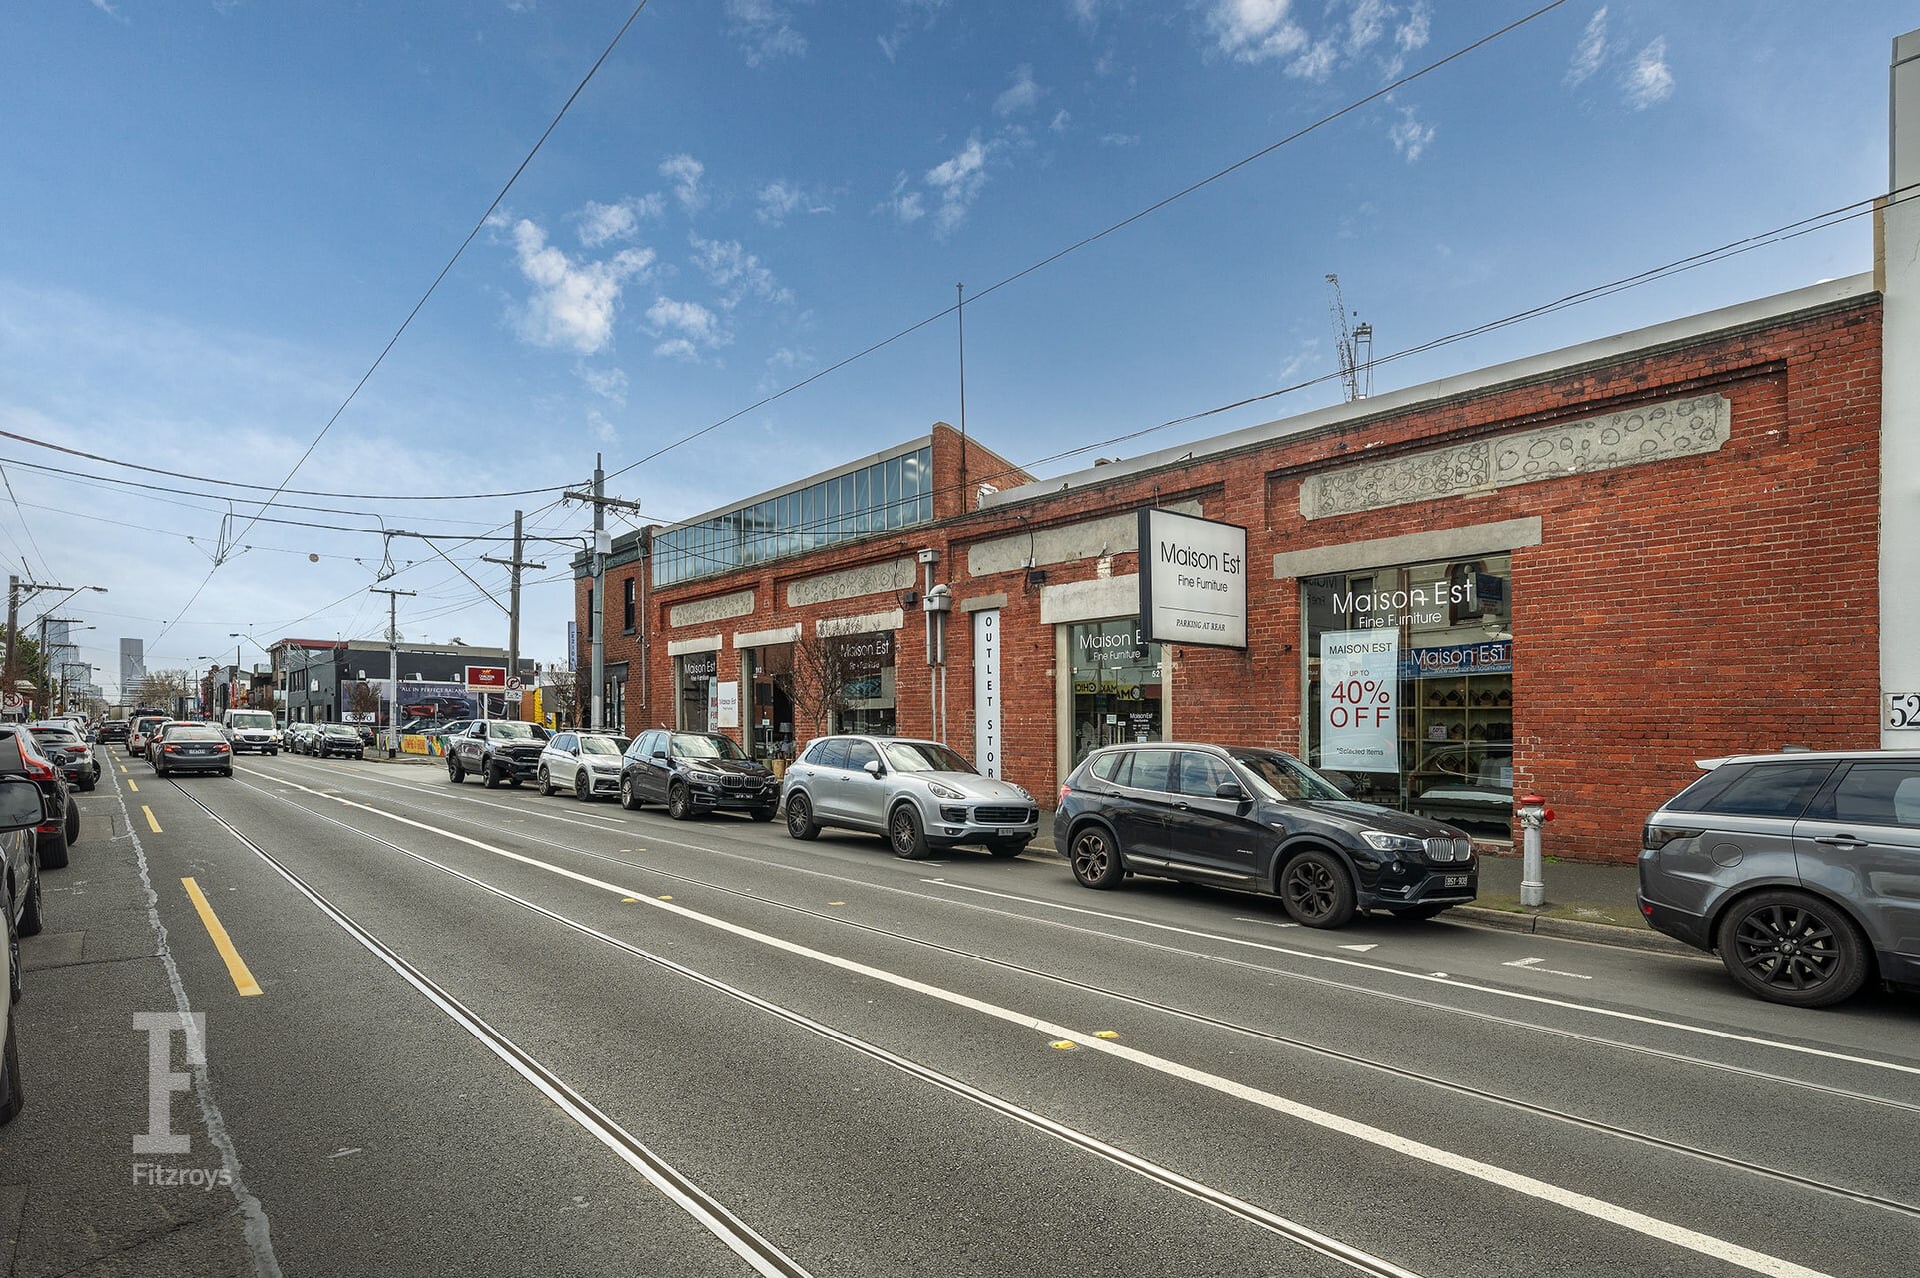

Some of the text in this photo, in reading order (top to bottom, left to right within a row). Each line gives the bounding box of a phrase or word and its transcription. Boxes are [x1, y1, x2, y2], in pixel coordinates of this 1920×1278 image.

[1161, 541, 1240, 574] Maison Est
[1178, 574, 1228, 592] Fine Furniture
[1333, 588, 1425, 614] Maison
[1435, 579, 1473, 605] Est
[1176, 619, 1226, 632] PARKING AT REAR
[1359, 611, 1442, 629] Fine Furniture
[841, 640, 890, 658] Maison Est
[1080, 633, 1131, 649] Maison
[1329, 643, 1393, 655] MAISON EST
[985, 616, 993, 707] OUTLET
[1093, 650, 1141, 661] Fine Furniture
[1411, 645, 1505, 666] Maison Est
[684, 660, 716, 674] Maison Est
[1360, 669, 1370, 677] TO
[1331, 679, 1390, 704] 40%
[1330, 706, 1391, 728] OFF
[1890, 694, 1920, 728] 52
